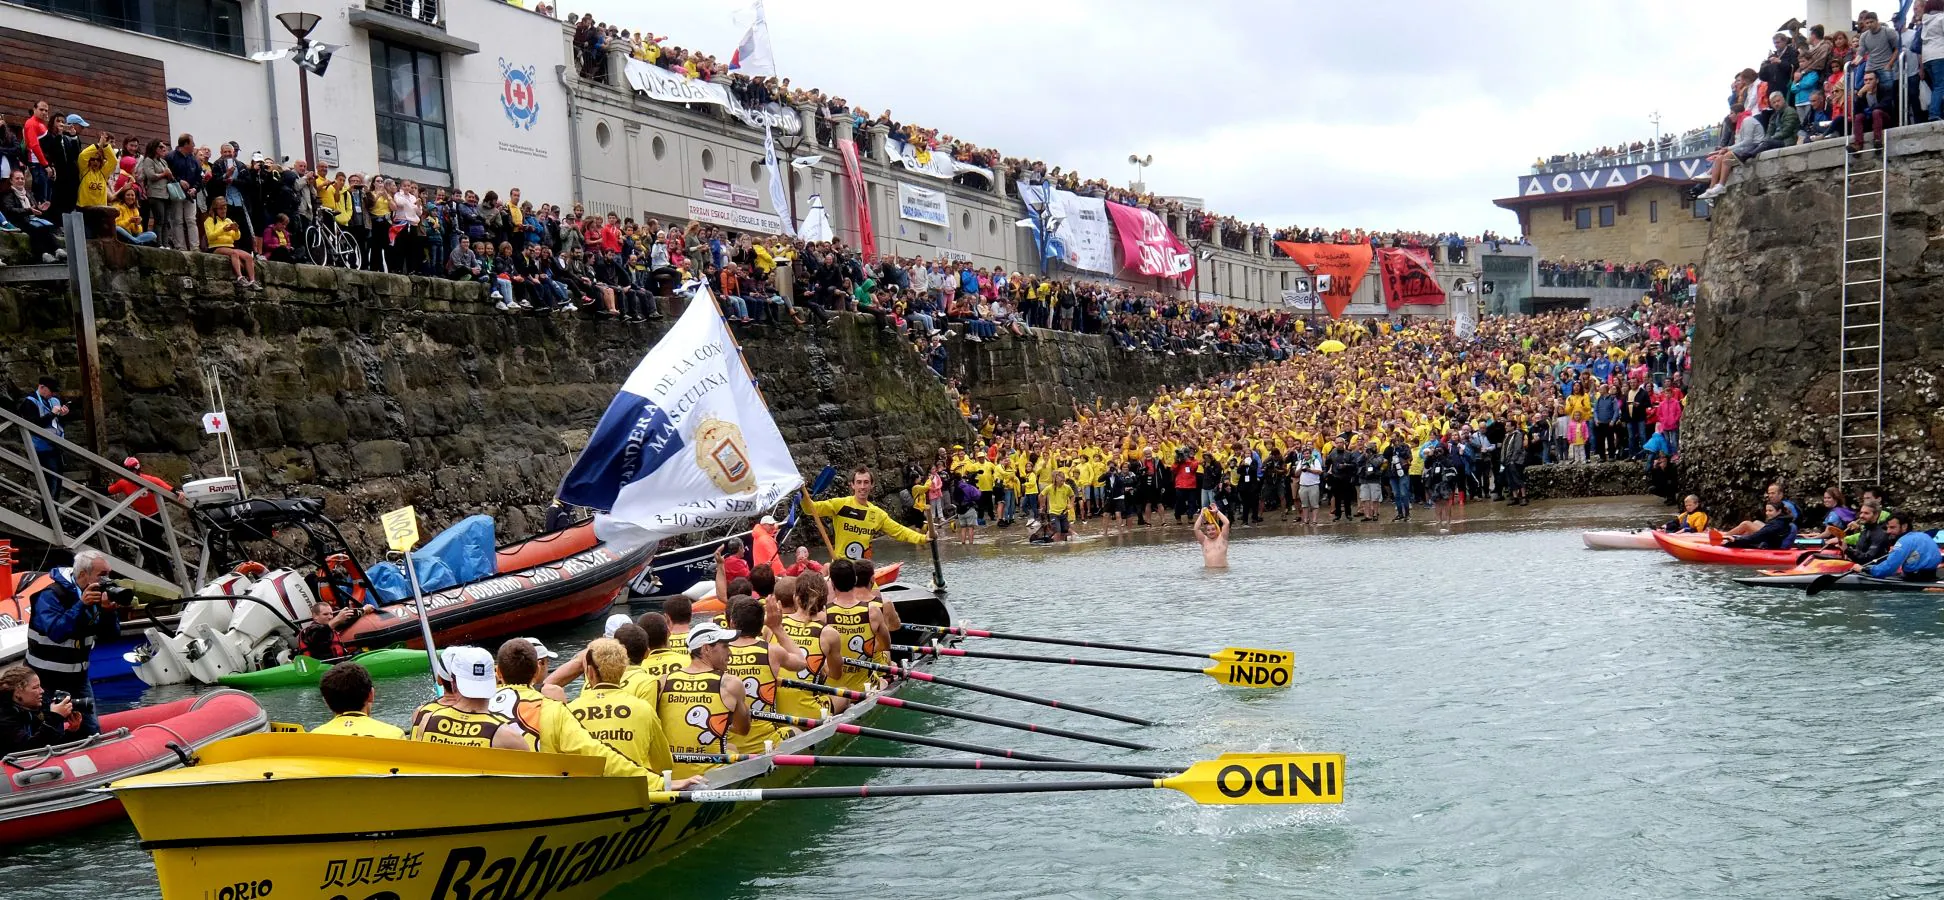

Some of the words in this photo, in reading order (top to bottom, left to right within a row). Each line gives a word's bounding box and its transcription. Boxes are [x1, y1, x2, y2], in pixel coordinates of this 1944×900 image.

[1525, 158, 1702, 196] AQVARIV
[654, 374, 677, 396] DE
[672, 359, 695, 375] LA
[694, 341, 724, 361] CON
[648, 372, 729, 455] MASCULINA
[209, 483, 239, 493] Rayma
[655, 513, 687, 526] 3-10
[466, 576, 523, 601] GOBIERNO
[528, 565, 561, 586] VASCO
[564, 550, 613, 575] RESCATE
[1229, 664, 1289, 687] INDO
[667, 693, 713, 705] Babyauto
[751, 708, 787, 720] CaixaBank
[674, 754, 713, 764] CaixaBank
[1216, 761, 1337, 799] INDO
[319, 852, 425, 890] 贝贝奥托
[430, 829, 672, 900] Babyauto
